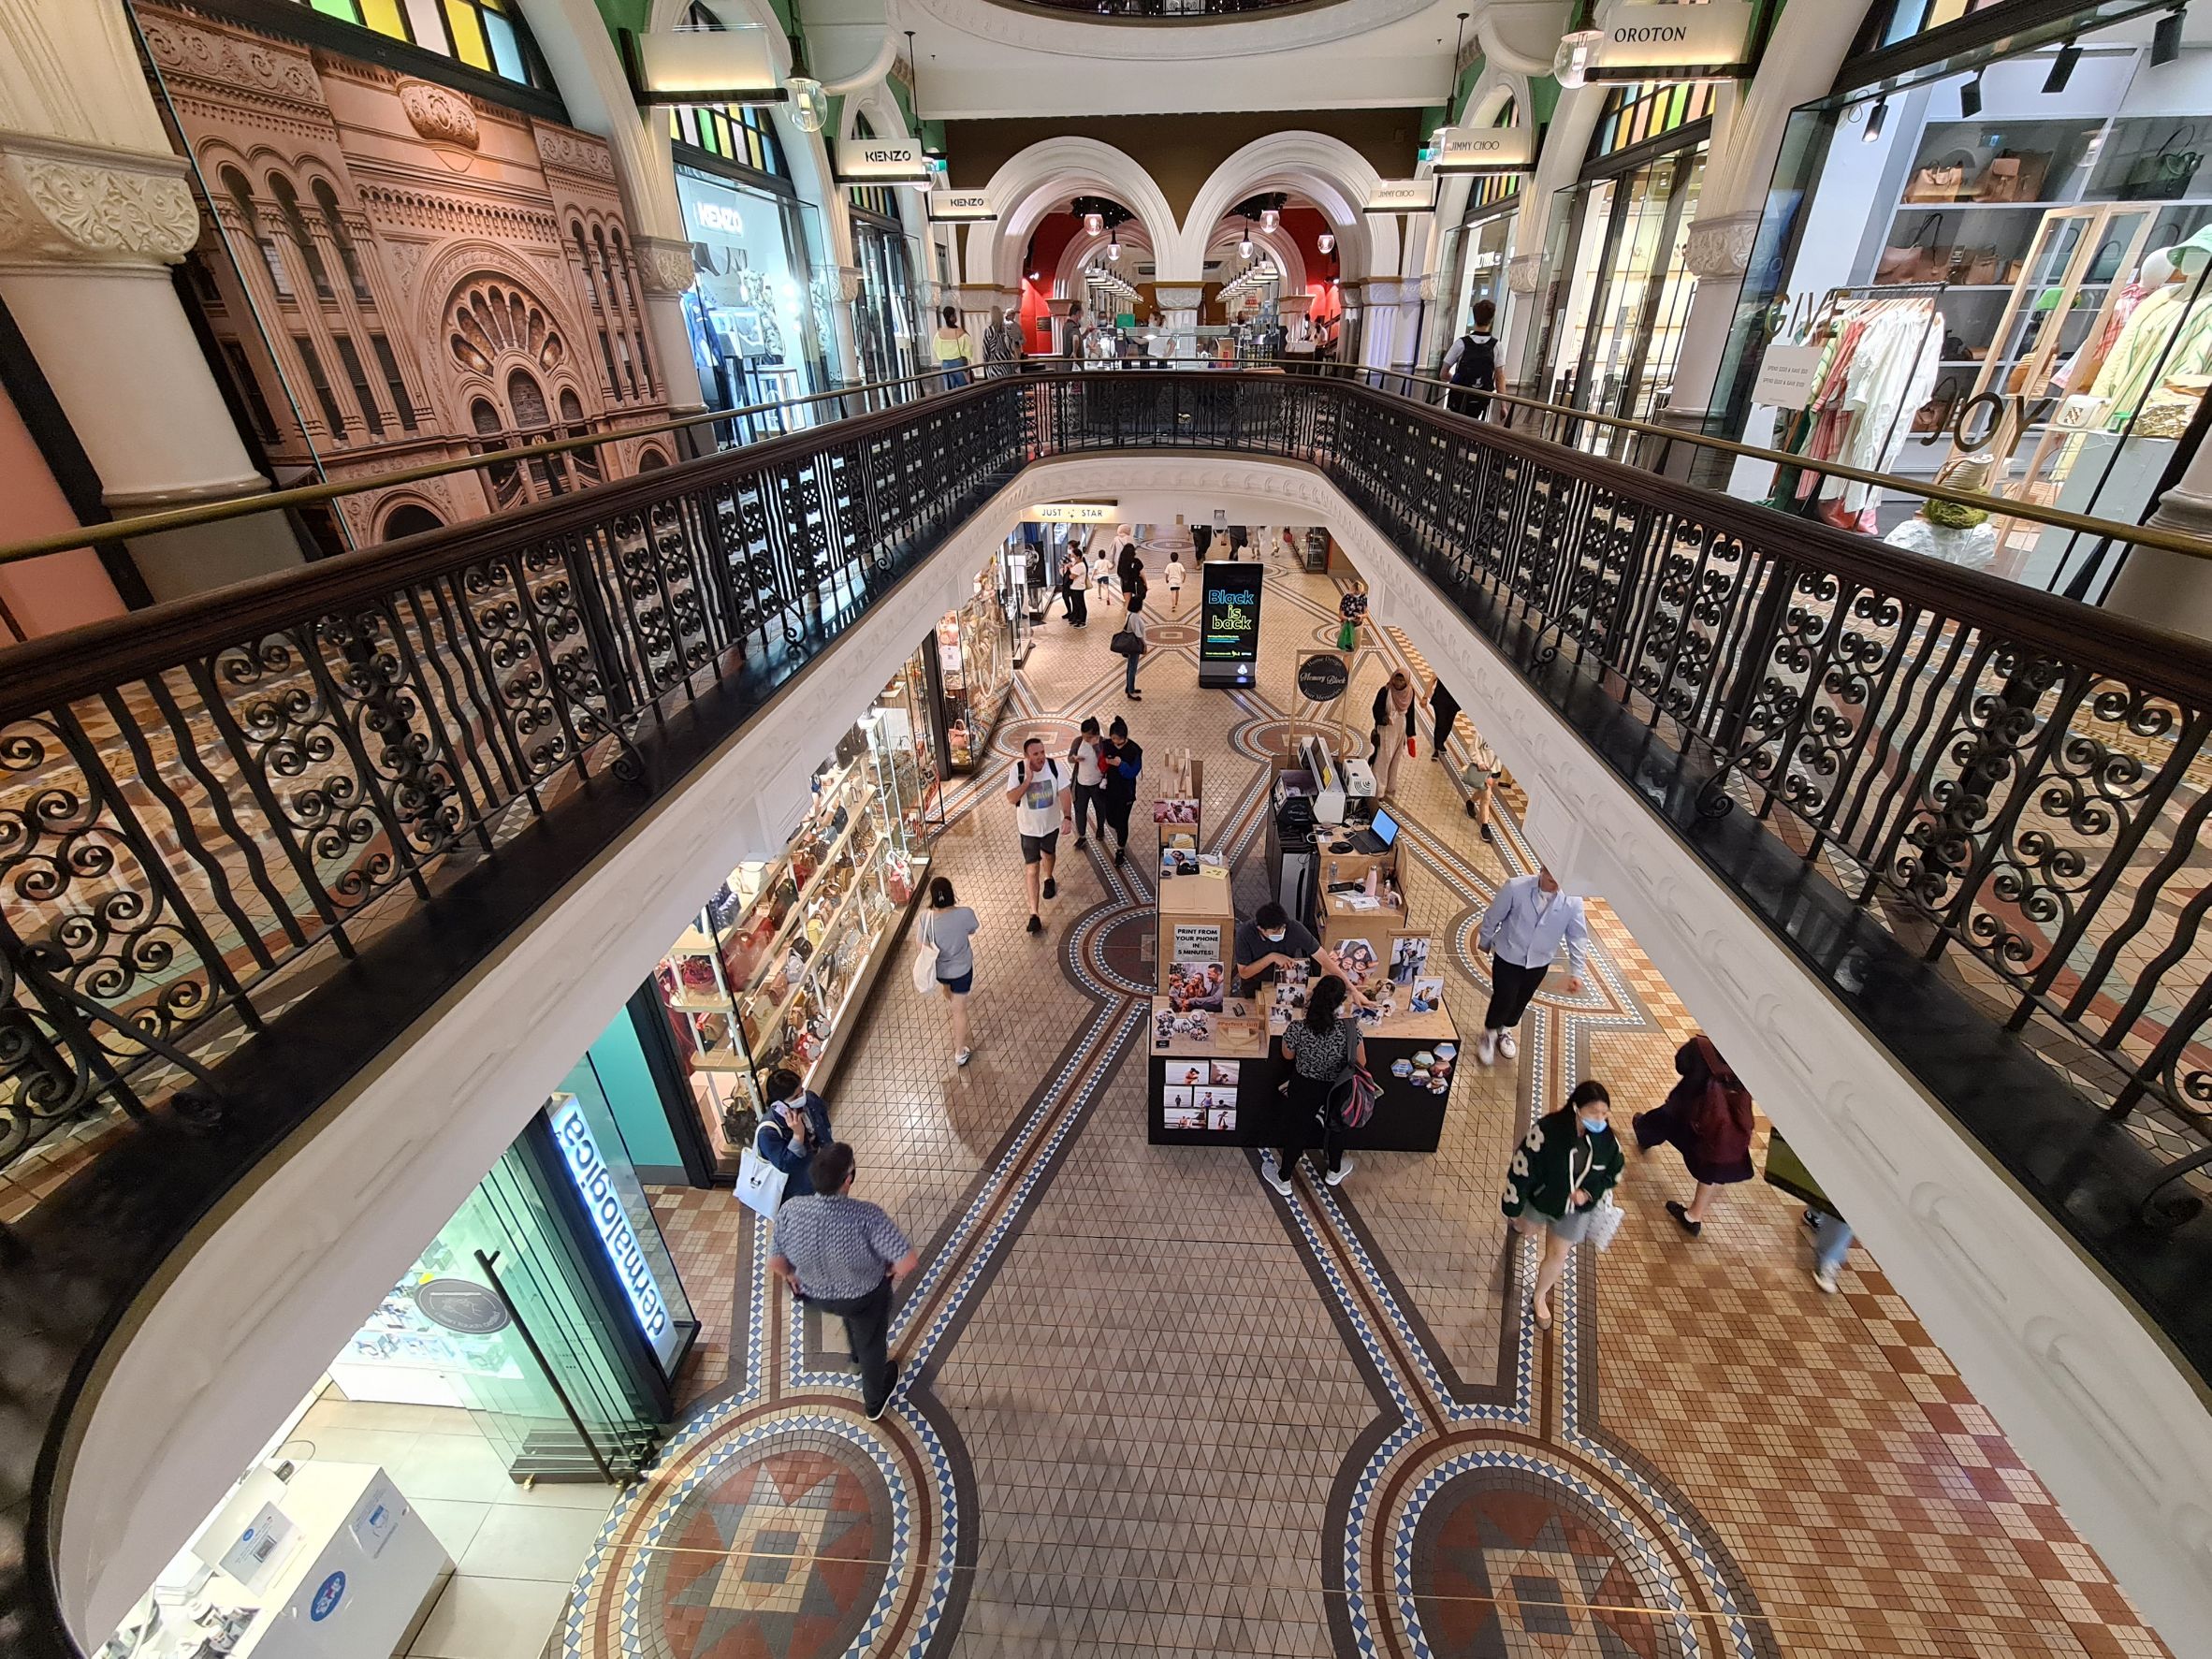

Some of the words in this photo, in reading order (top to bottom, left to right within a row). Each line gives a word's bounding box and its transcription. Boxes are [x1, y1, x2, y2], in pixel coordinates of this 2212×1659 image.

[1614, 26, 1687, 43] OROTON
[1449, 141, 1473, 152] JIMMY
[1473, 140, 1500, 151] CHOO
[865, 150, 911, 162] KENZO
[1378, 190, 1395, 198] JIMMY
[950, 197, 984, 207] KENZO
[697, 200, 743, 234] KENZO
[1765, 292, 1852, 338] GIVE
[1921, 389, 2054, 457] JOY
[1041, 508, 1062, 517] JUST
[1082, 509, 1103, 517] STAR
[1208, 589, 1255, 604] Black
[1228, 604, 1242, 618] is
[1212, 616, 1252, 630] back
[563, 1110, 666, 1338] dermalogica
